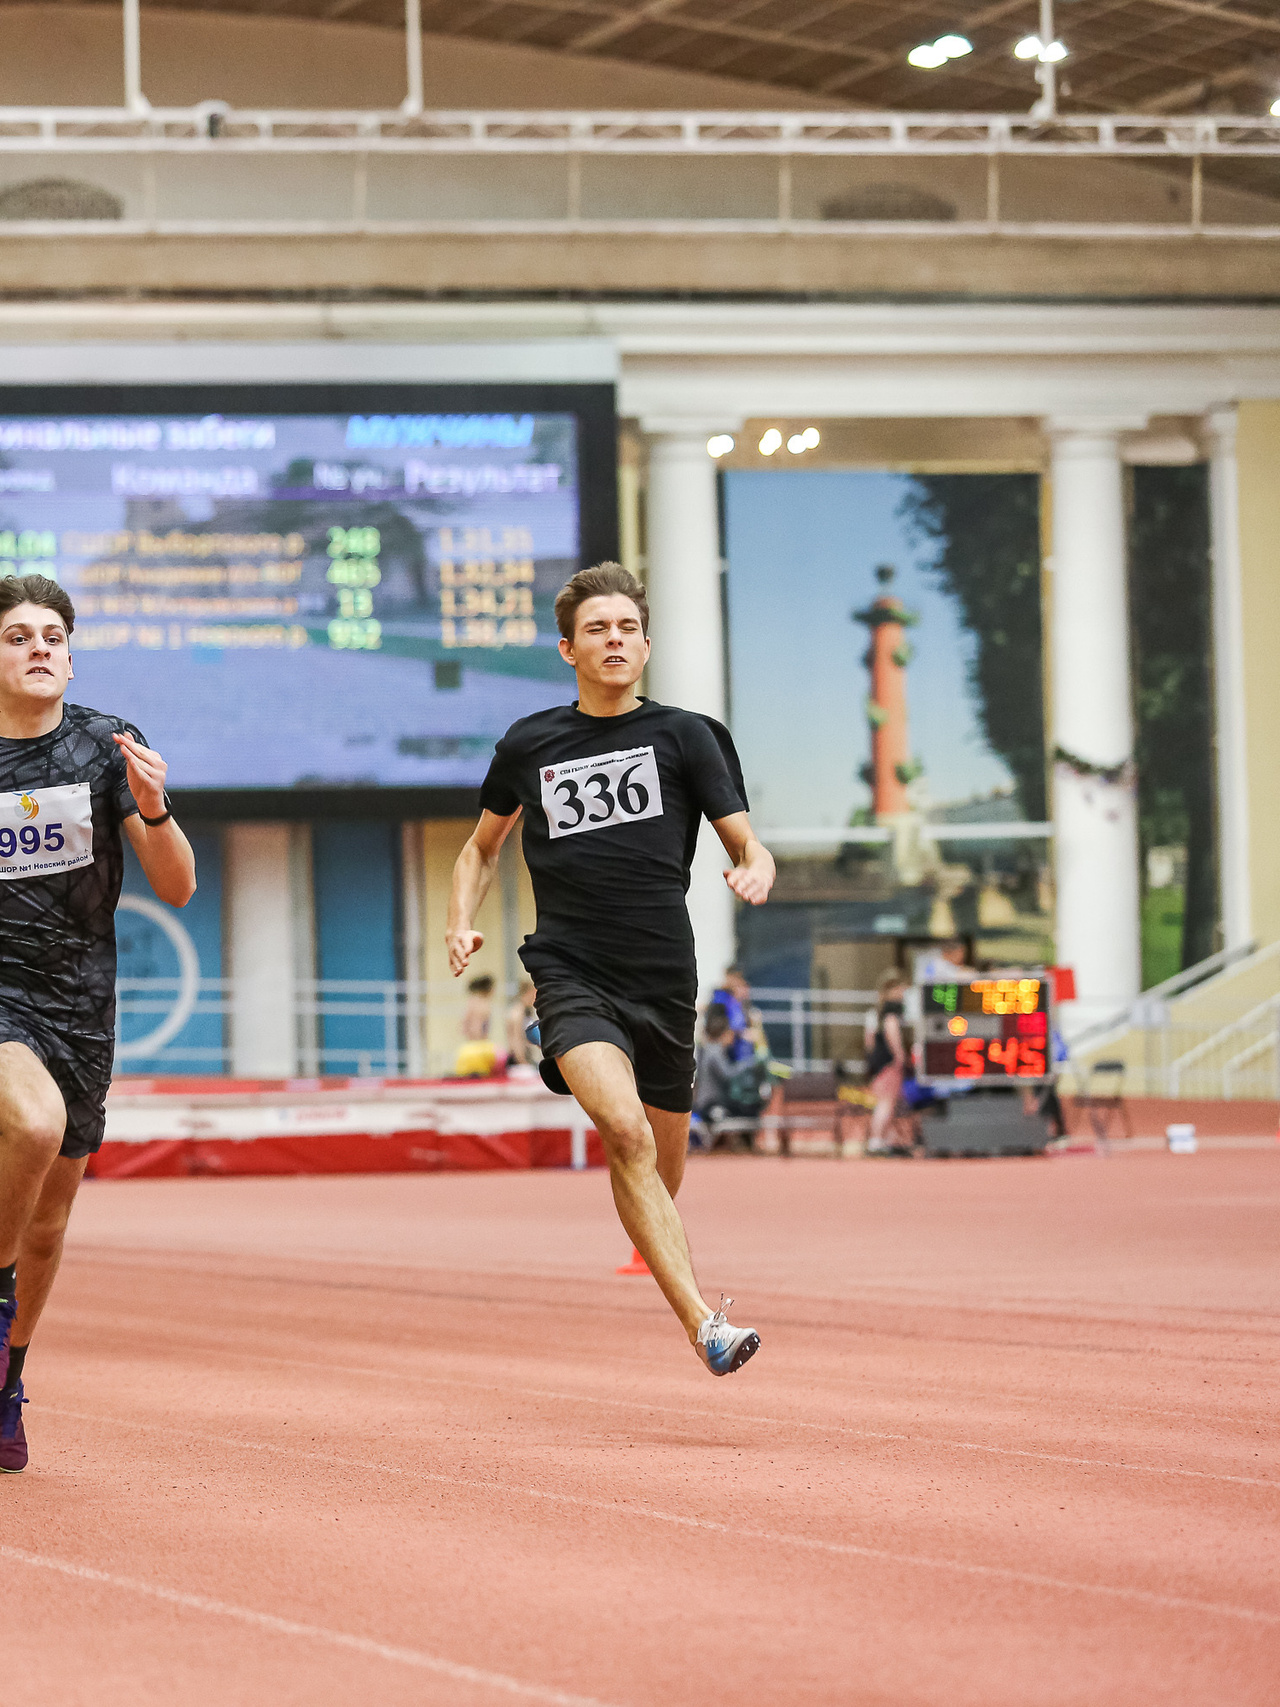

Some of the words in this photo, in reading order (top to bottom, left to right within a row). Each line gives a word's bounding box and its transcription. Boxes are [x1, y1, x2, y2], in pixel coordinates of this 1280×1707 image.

[165, 415, 276, 450] забеги
[111, 461, 258, 496] Команда
[404, 460, 561, 497] Результат
[554, 763, 649, 829] 336
[33, 859, 66, 870] Невский
[67, 855, 89, 867] район
